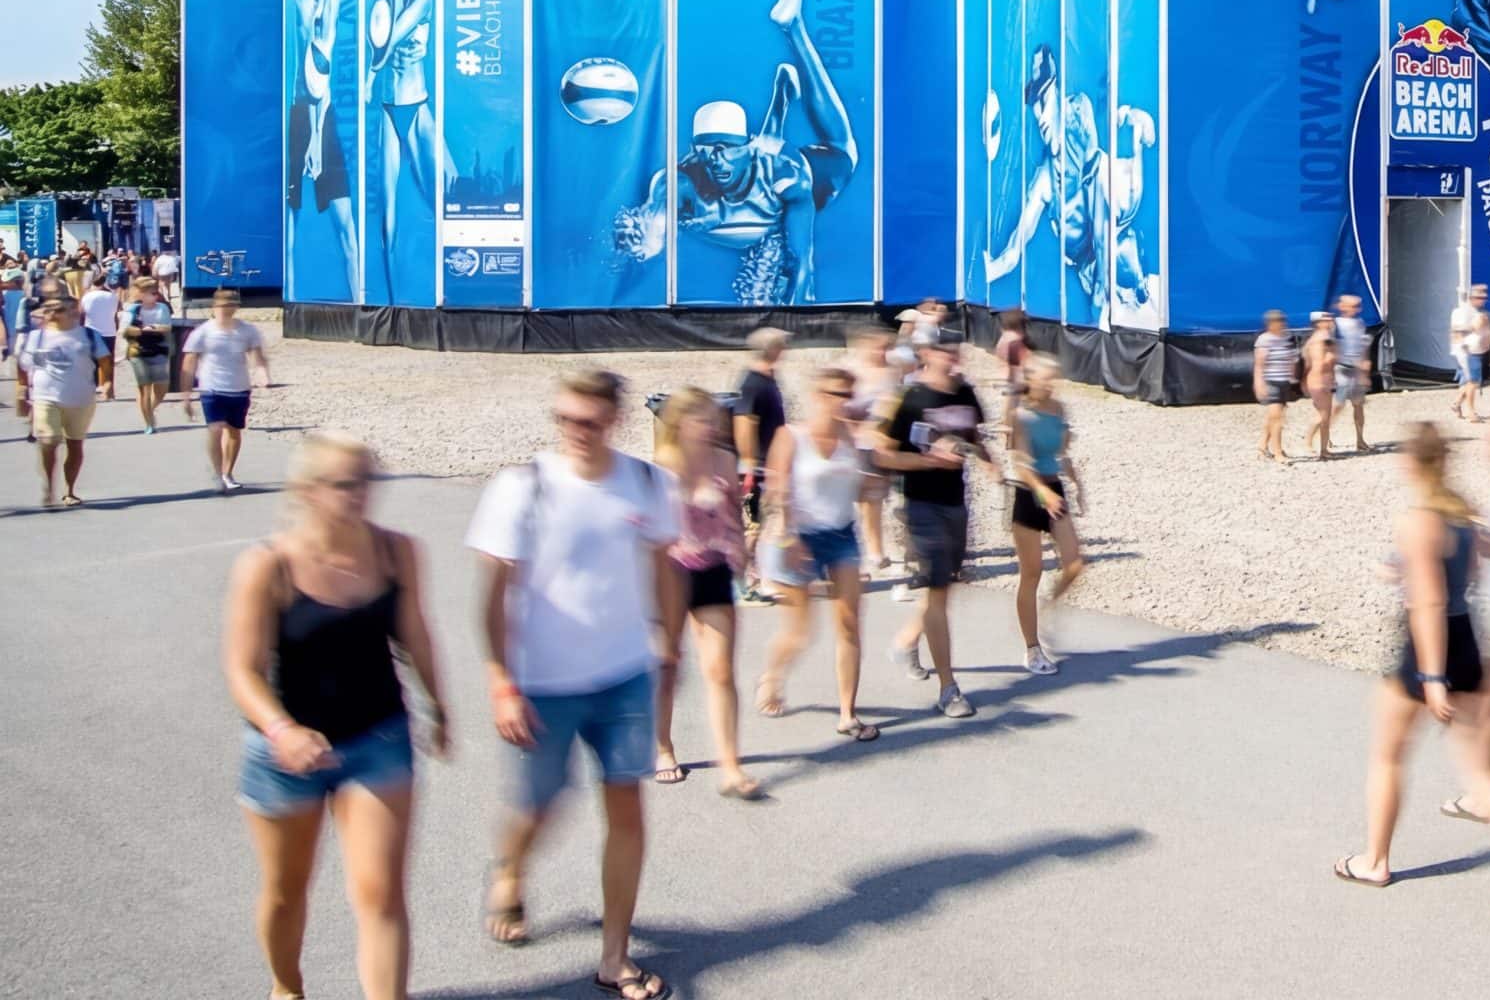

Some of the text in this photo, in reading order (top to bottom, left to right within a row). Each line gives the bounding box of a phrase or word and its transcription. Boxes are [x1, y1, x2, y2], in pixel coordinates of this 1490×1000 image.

[1395, 80, 1472, 108] BEACH
[1299, 22, 1344, 212] NORWAY
[1395, 108, 1472, 136] ARENA
